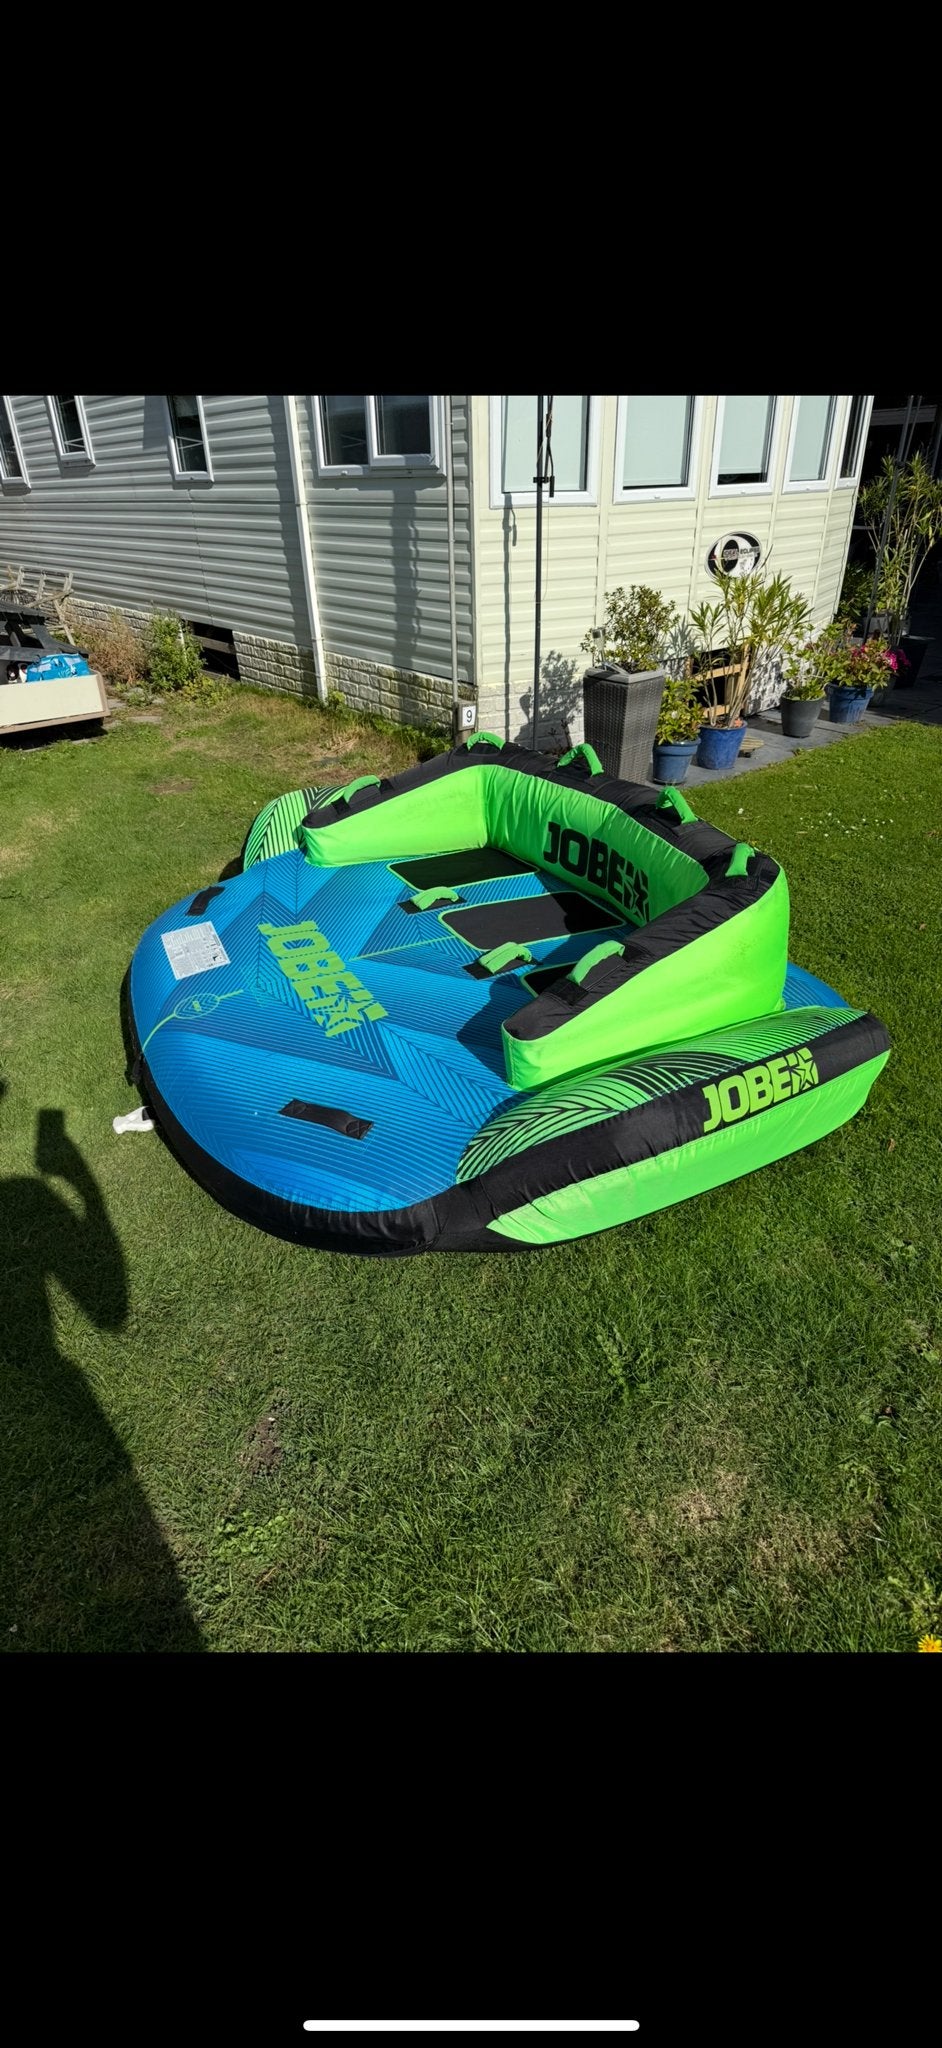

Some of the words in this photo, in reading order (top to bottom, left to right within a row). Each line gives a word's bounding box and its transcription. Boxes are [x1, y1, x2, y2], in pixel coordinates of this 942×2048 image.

[466, 709, 473, 723] 9
[543, 821, 626, 904] JOBE
[257, 920, 364, 1010] JOBE
[702, 1056, 792, 1133] JOBE
